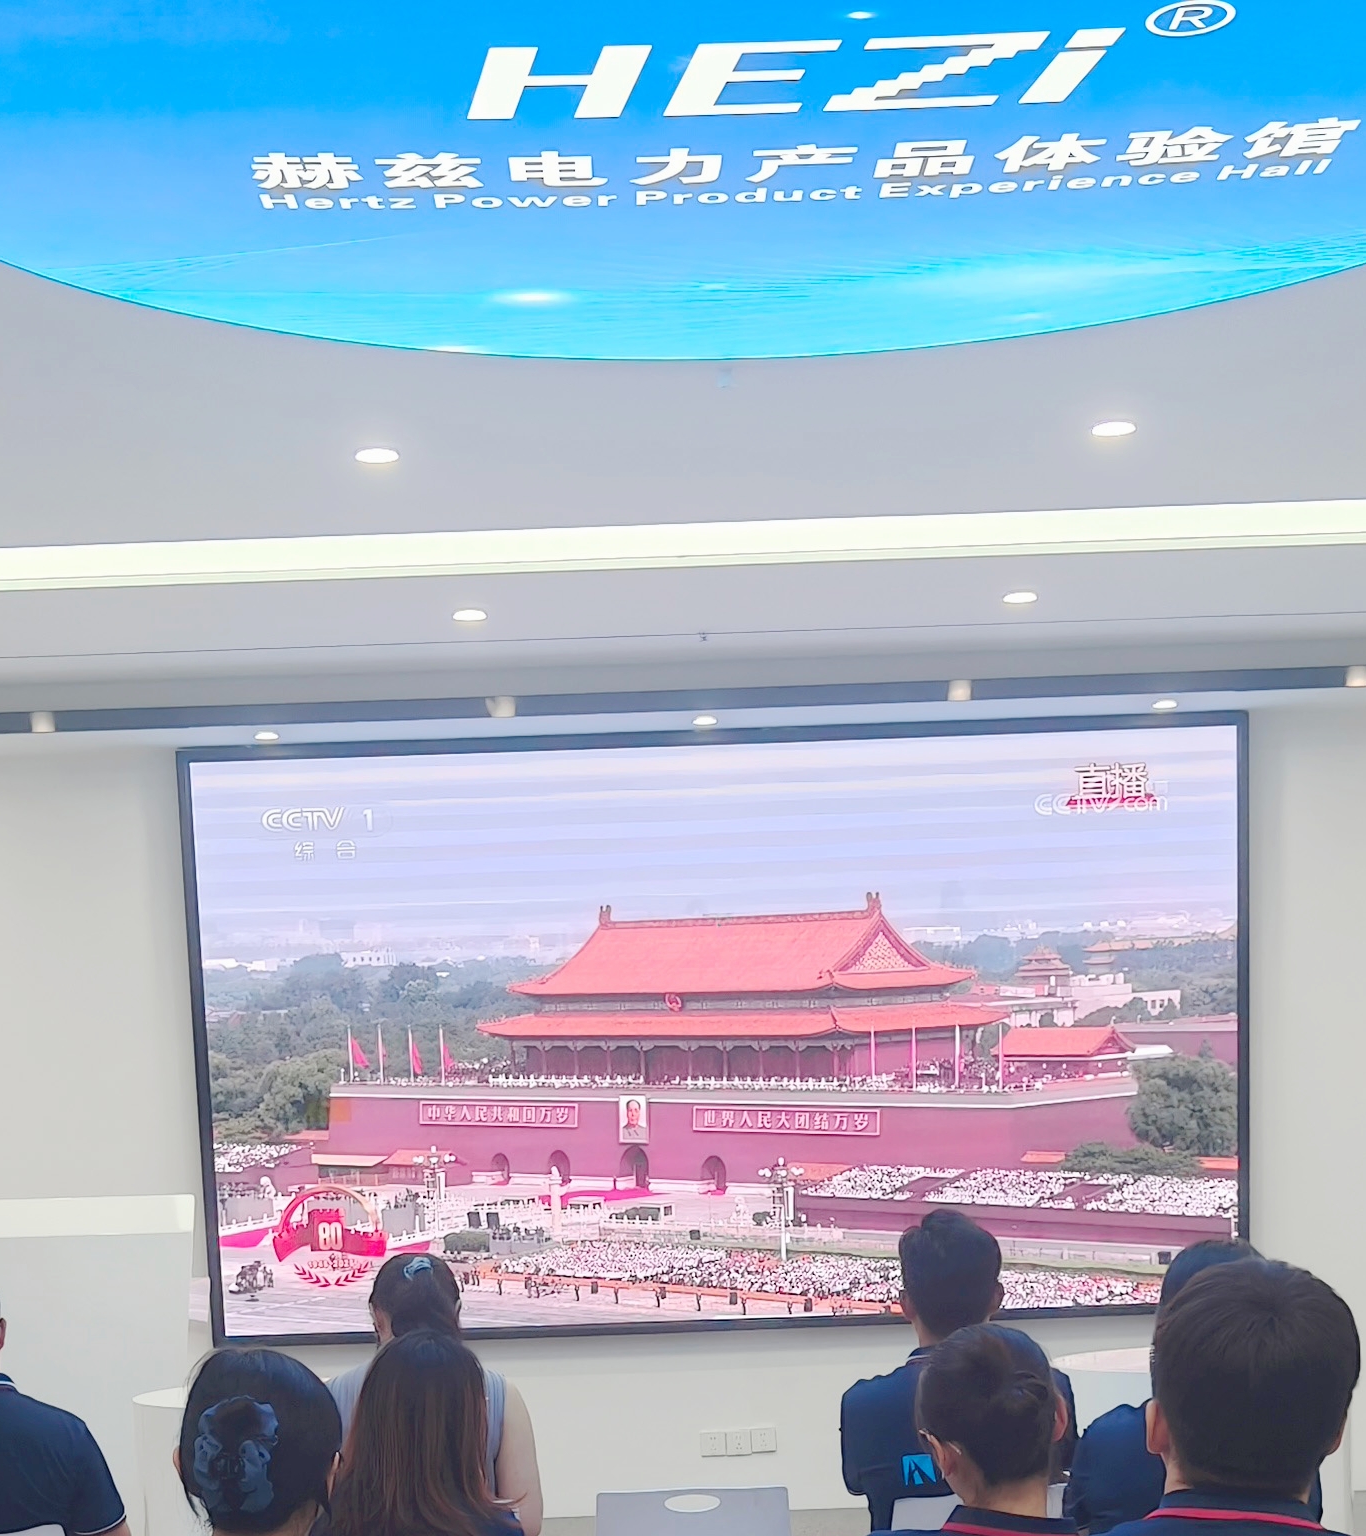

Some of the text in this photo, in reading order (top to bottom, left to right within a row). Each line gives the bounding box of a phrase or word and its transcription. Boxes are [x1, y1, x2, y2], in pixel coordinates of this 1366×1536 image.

[251, 117, 1362, 190] 赫兹电力产品体验馆
[258, 158, 1333, 211] Hertz Power Product Experience Hall
[1074, 762, 1149, 798] 直播
[261, 806, 374, 832] CCTV 1
[294, 840, 357, 862] 综合
[427, 1105, 570, 1124] 中华人民共和国万岁
[703, 1109, 870, 1132] 世界人民大团结万岁
[318, 1221, 344, 1250] 80
